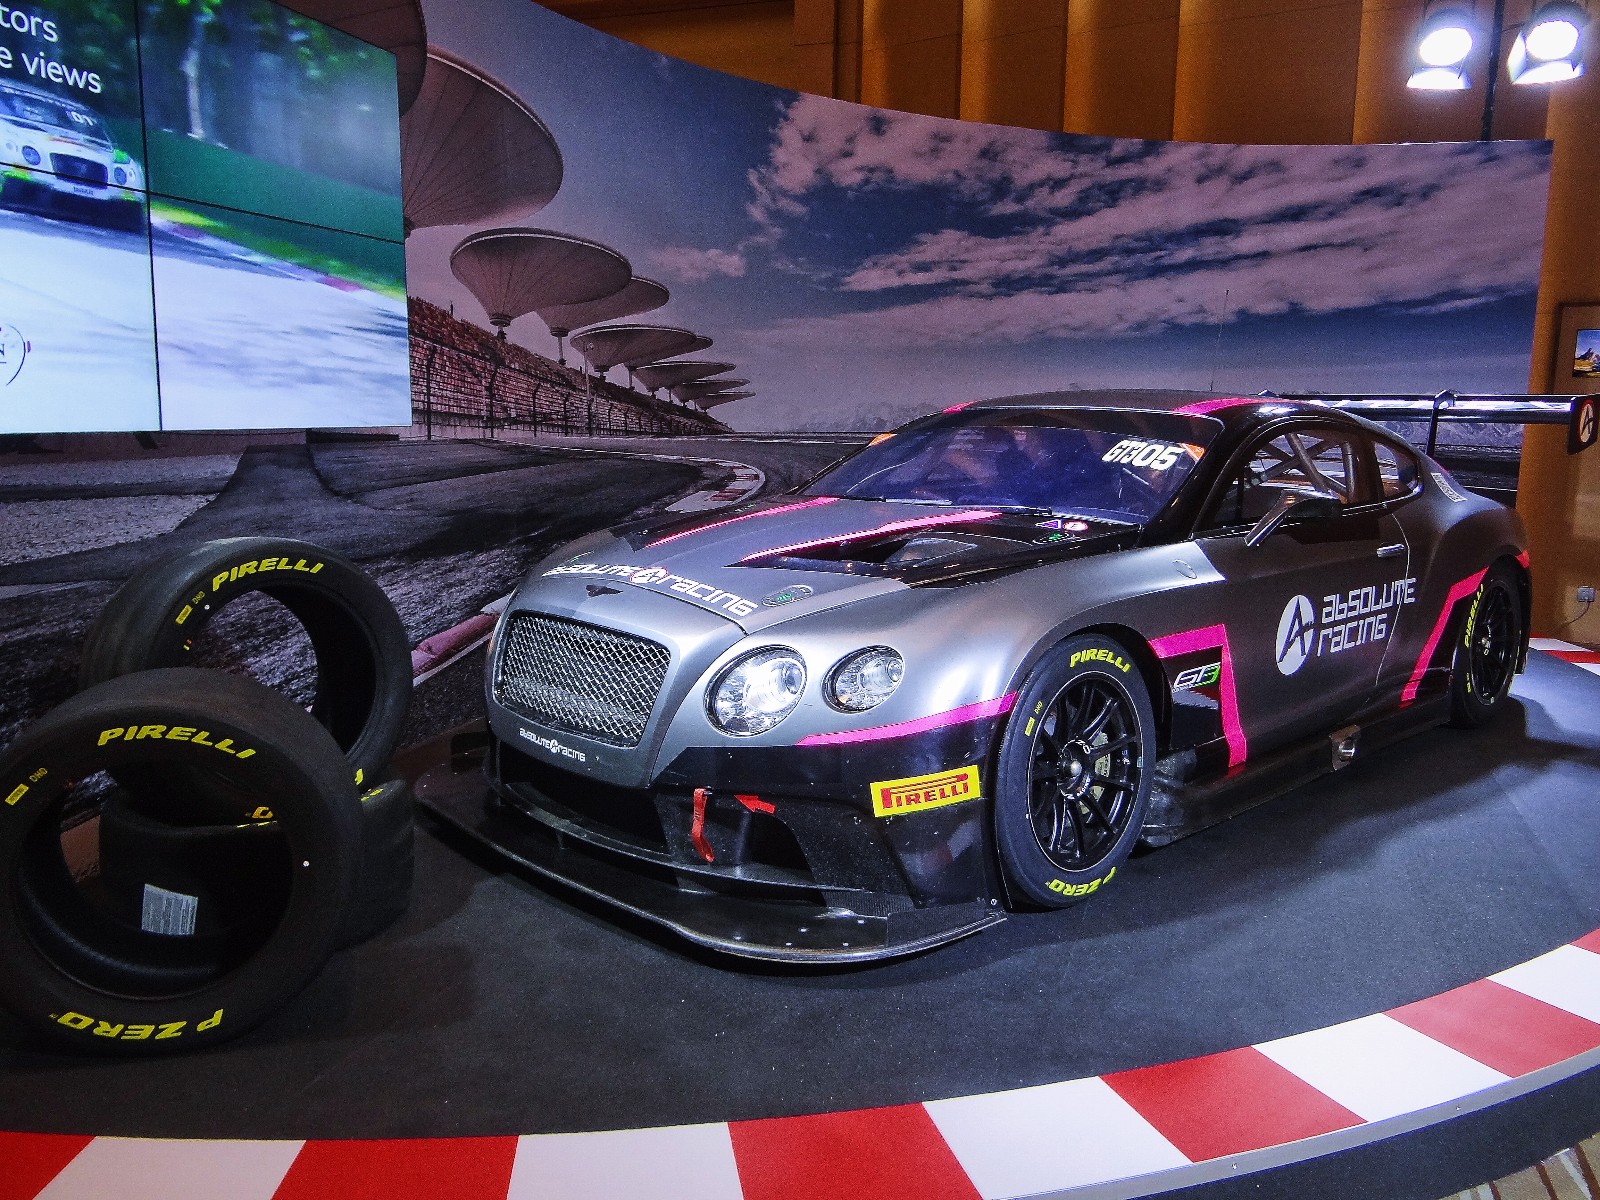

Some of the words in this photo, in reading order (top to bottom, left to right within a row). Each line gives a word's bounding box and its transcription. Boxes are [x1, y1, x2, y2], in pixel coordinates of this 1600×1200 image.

[21, 51, 103, 94] views
[212, 557, 324, 592] PIRELLI
[1069, 648, 1131, 673] PIRELLI
[97, 724, 257, 759] PIRELLI
[880, 772, 969, 809] PIRELLI
[1047, 878, 1102, 896] ZERO
[56, 1011, 188, 1040] ZERO
[196, 1008, 224, 1032] P
